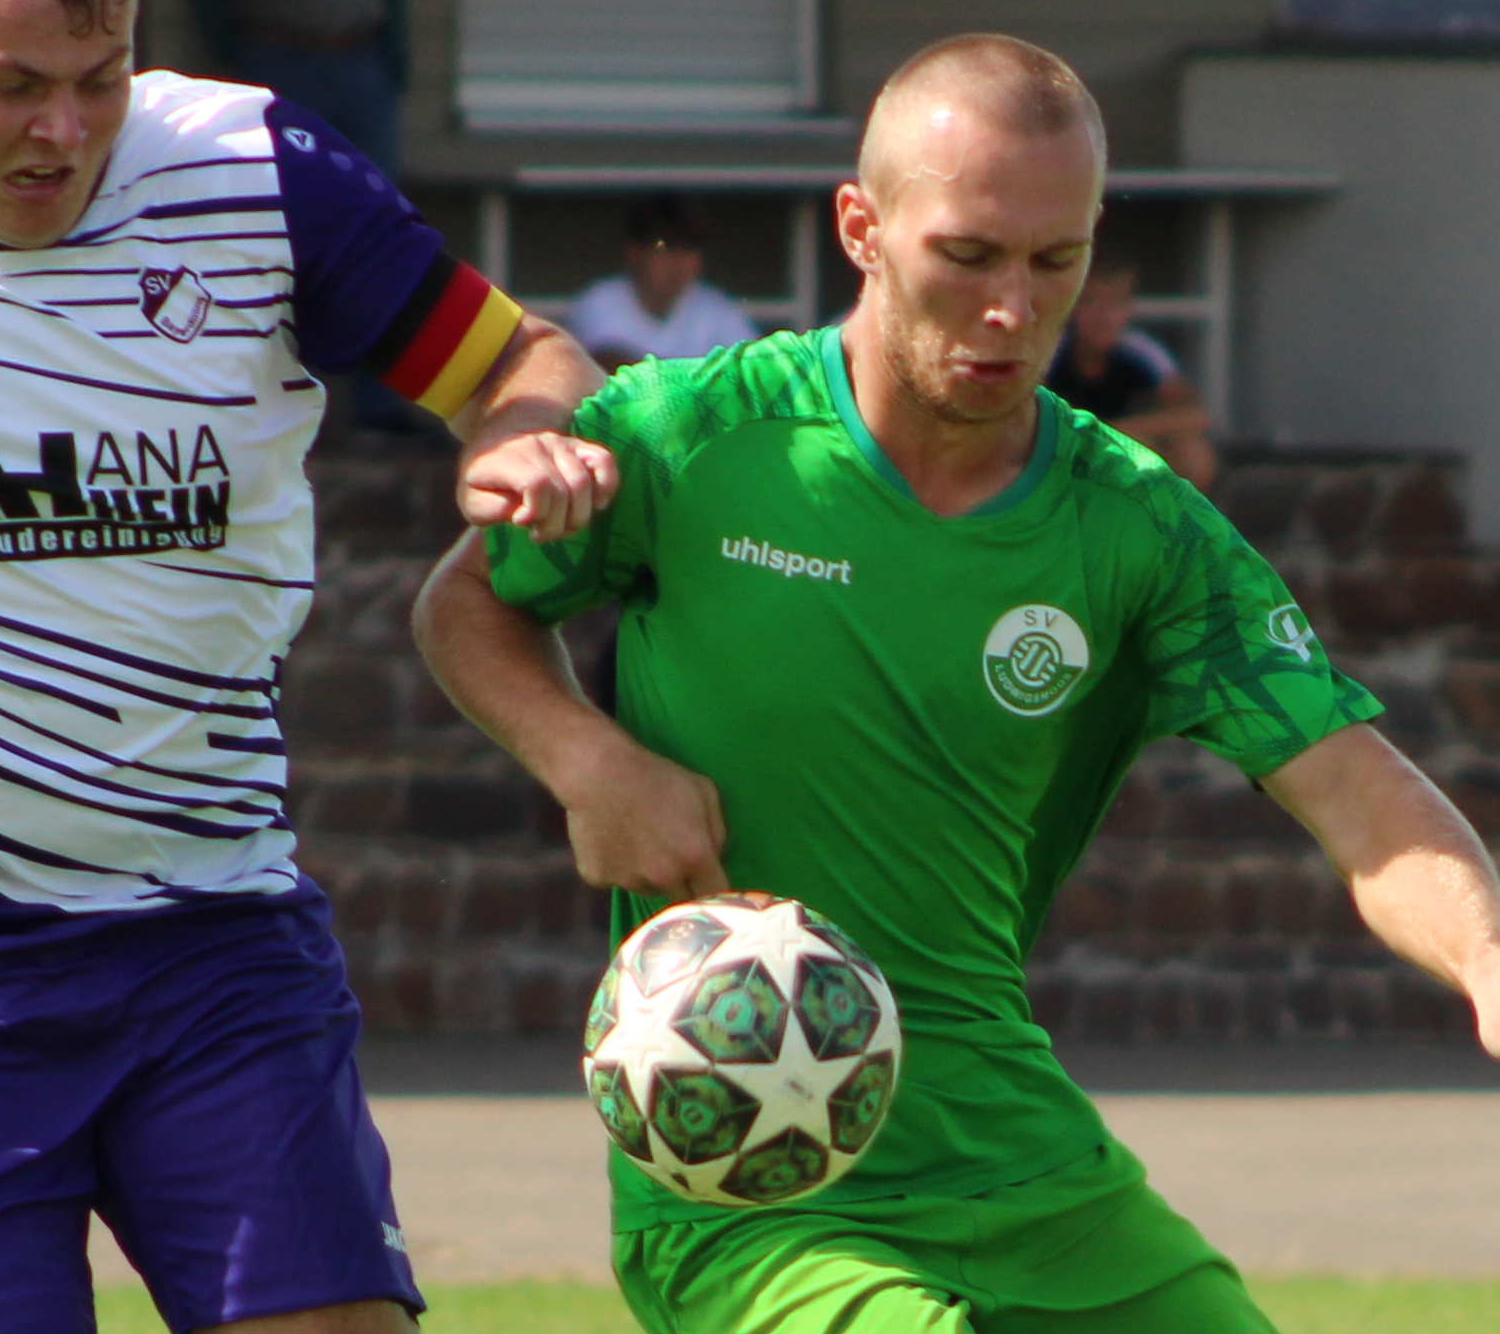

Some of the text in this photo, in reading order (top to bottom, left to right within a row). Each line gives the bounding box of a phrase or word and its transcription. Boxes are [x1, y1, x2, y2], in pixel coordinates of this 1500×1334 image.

[144, 272, 172, 296] SV
[86, 424, 230, 486] ANA
[721, 535, 852, 586] uhlsport
